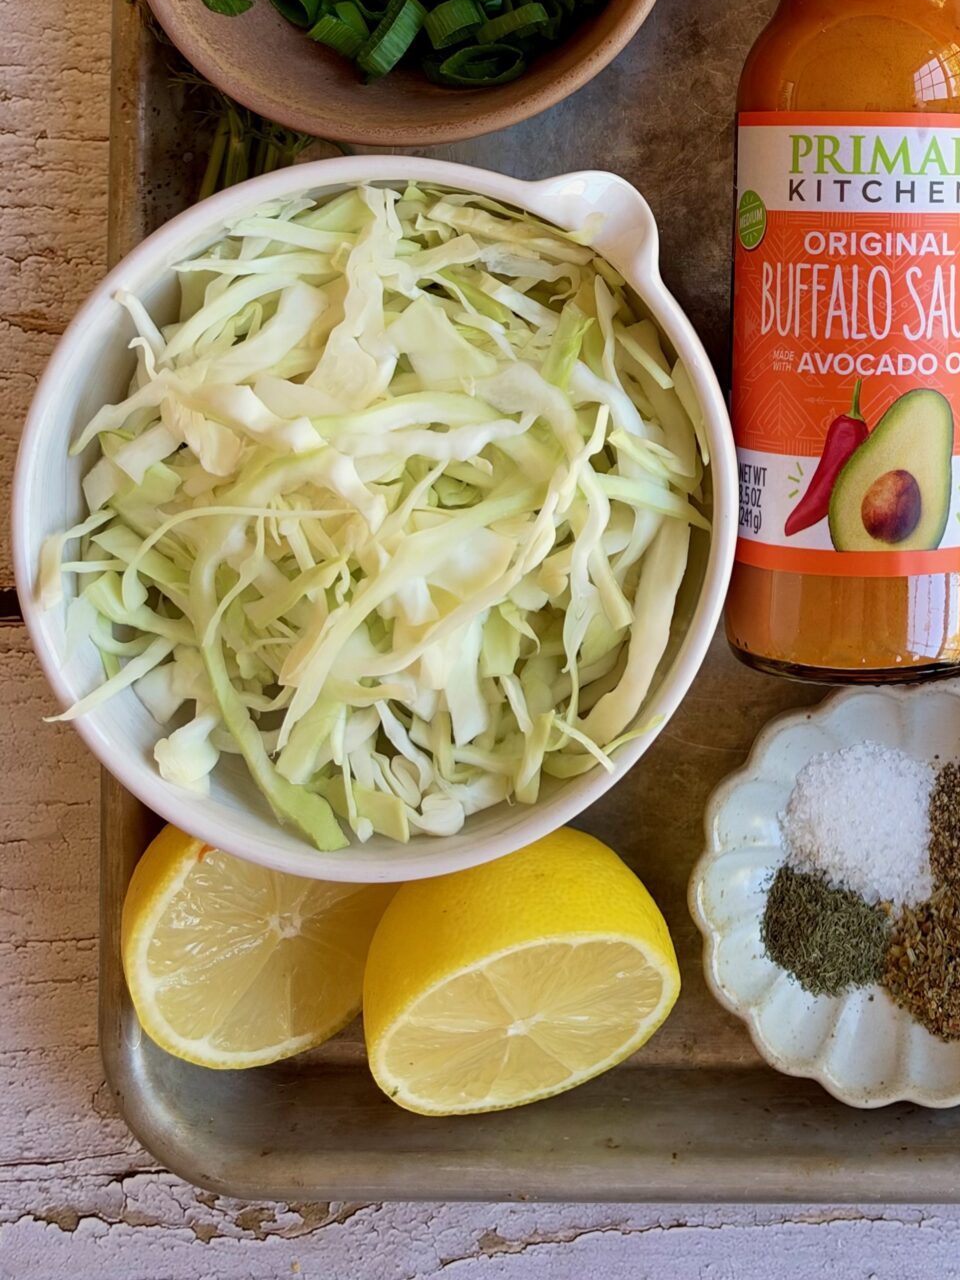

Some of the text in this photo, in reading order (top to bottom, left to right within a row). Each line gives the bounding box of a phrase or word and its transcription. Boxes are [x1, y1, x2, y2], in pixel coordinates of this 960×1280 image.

[804, 231, 956, 256] ORIGINAL
[760, 262, 892, 340] BUFFALO
[772, 350, 795, 361] MADE
[772, 361, 792, 372] WITH
[797, 352, 937, 376] AVOCADO
[753, 465, 767, 487] WT
